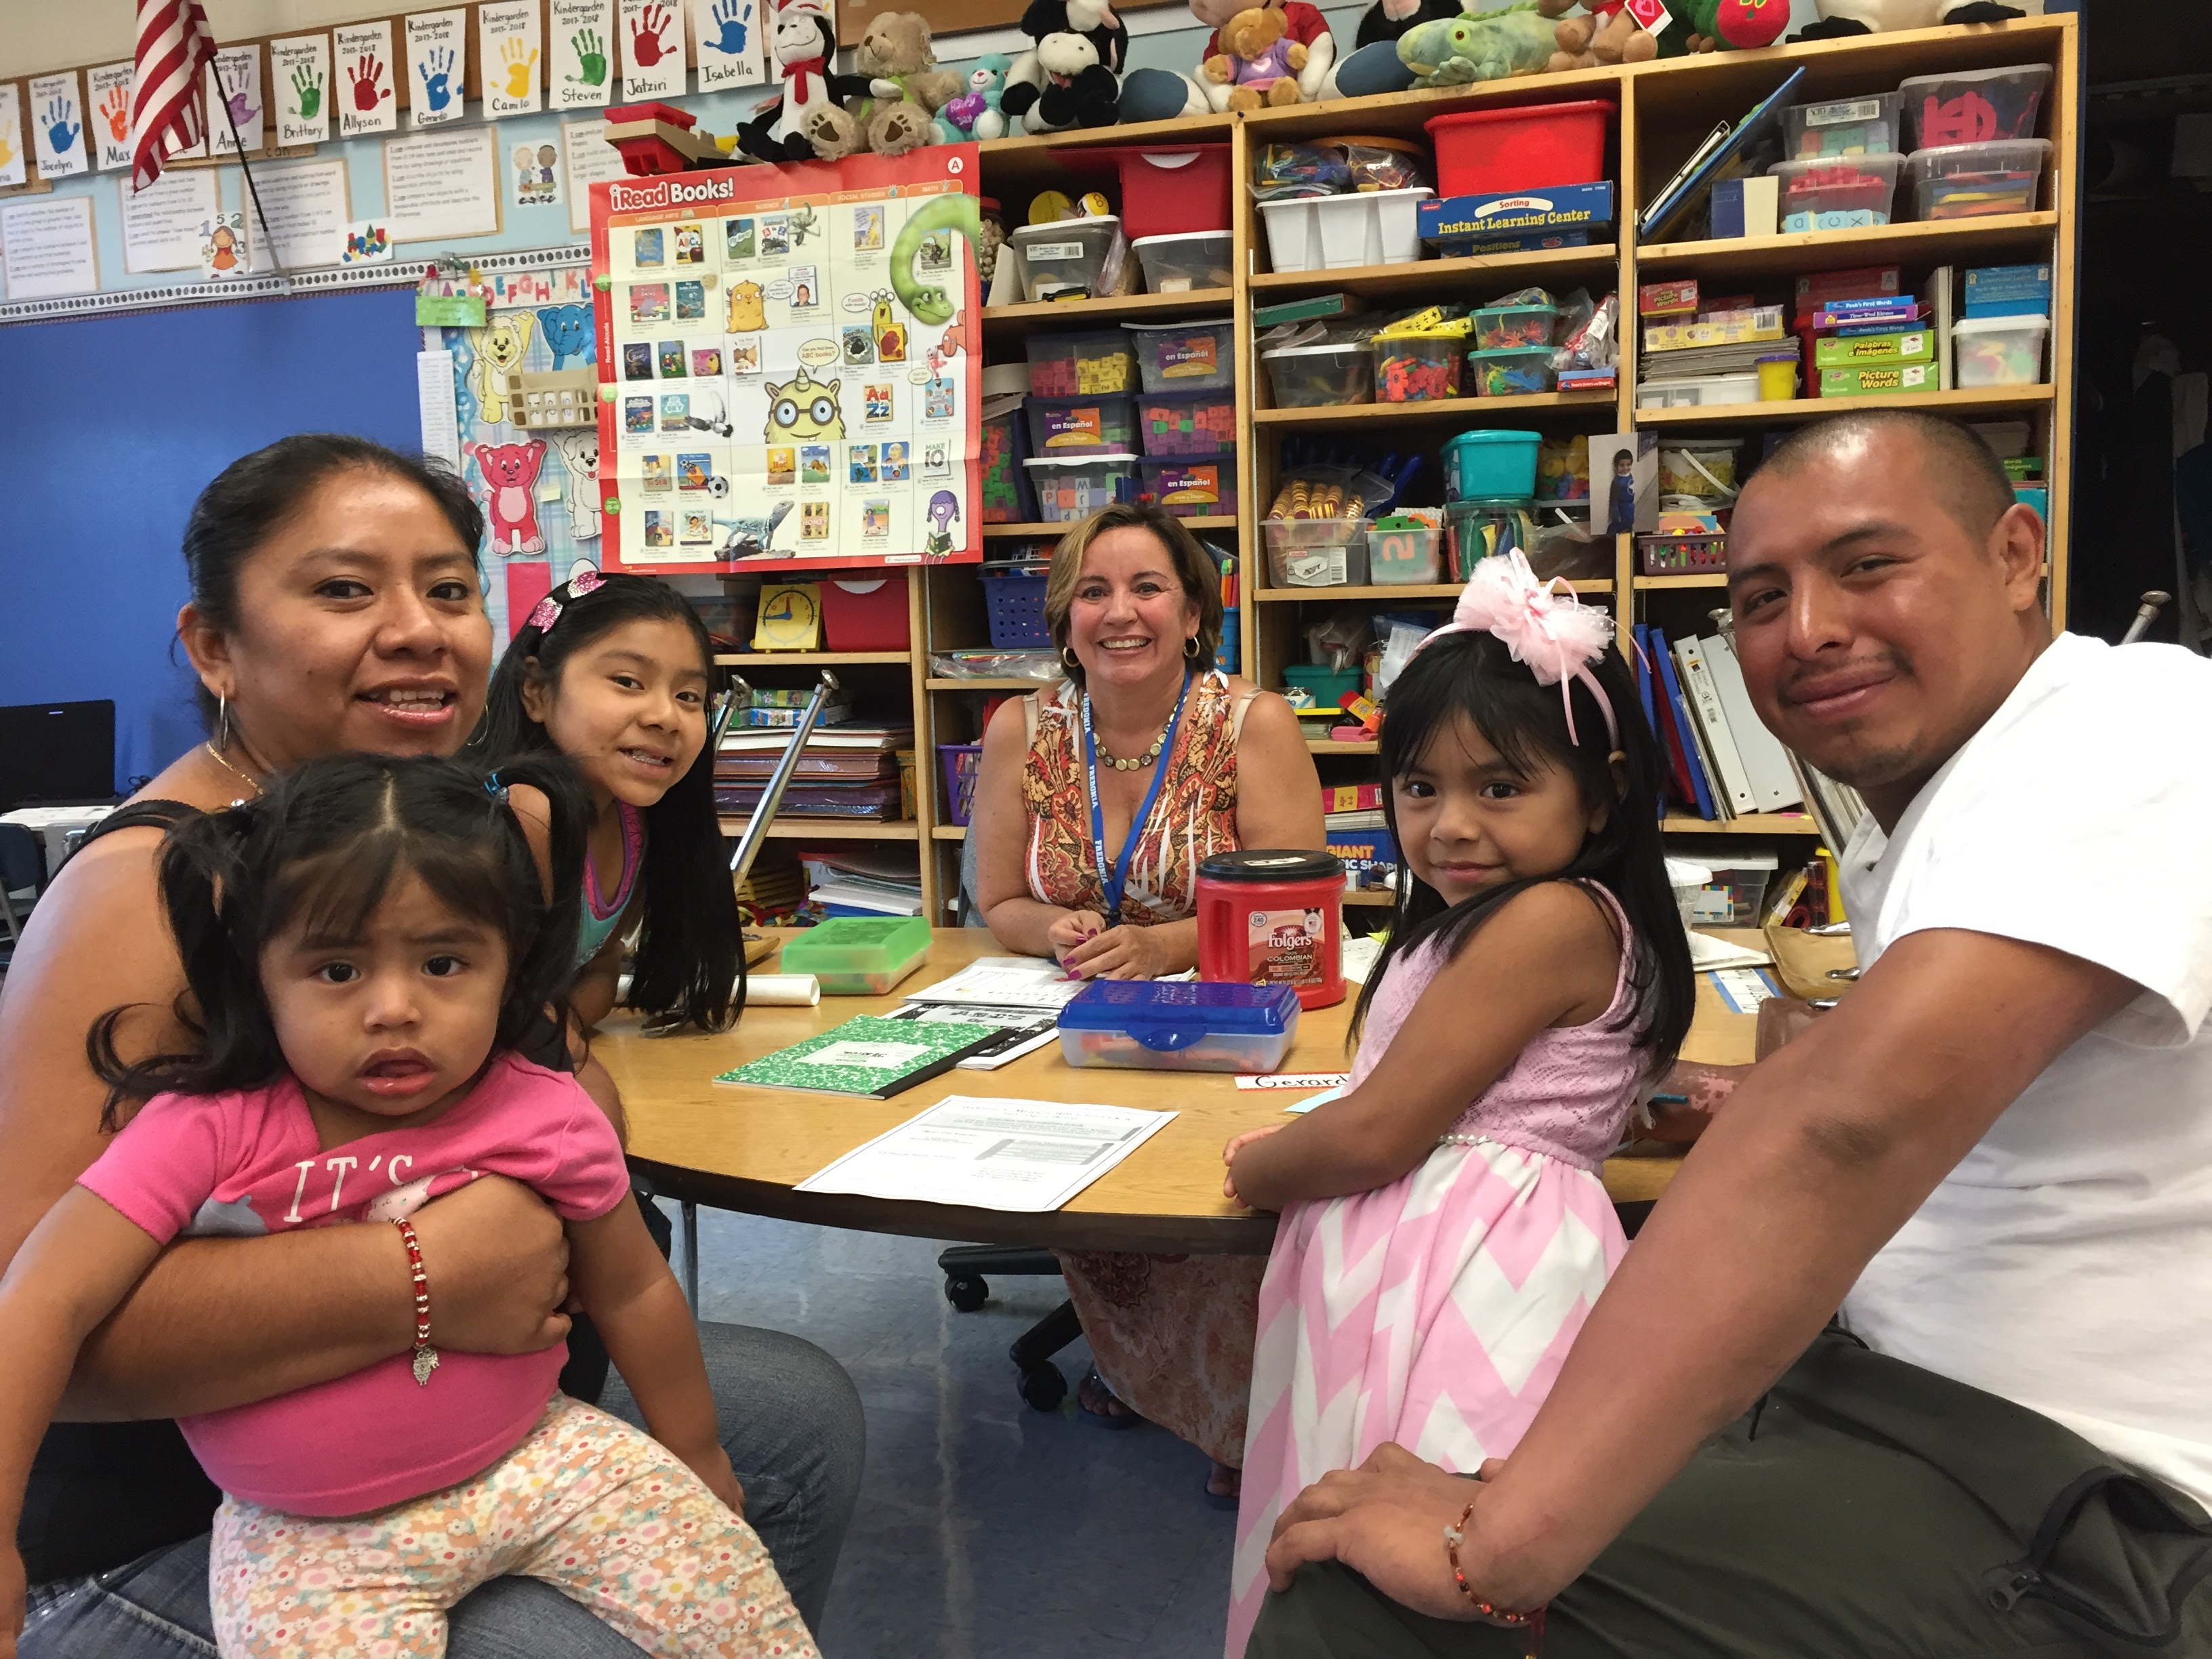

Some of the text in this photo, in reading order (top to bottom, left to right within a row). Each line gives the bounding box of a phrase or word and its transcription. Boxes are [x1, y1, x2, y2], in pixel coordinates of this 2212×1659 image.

[701, 60, 753, 83] Isabella
[626, 78, 667, 96] Jatziri
[562, 87, 602, 102] Steven
[492, 98, 529, 110] Camilo
[343, 112, 382, 132] Allyson
[106, 146, 131, 165] Max
[41, 159, 73, 173] Jocelyn
[951, 161, 960, 170] A
[610, 178, 734, 211] iRead Books!
[1500, 200, 1530, 209] Sorting
[1438, 209, 1591, 234] Instant Learning Center
[1472, 240, 1521, 253] Positions
[1854, 340, 1891, 350] Palabras
[1856, 346, 1898, 356] imágenes
[1858, 370, 1900, 380] Picture
[1862, 380, 1899, 389] Words
[1063, 421, 1093, 430] Español
[925, 450, 945, 467] 10
[1179, 478, 1210, 487] Español
[1083, 693, 1091, 736] FREDONIA
[1089, 765, 1099, 810] FREDONIA
[1326, 845, 1374, 858] GIANT
[1095, 840, 1108, 886] FREDONIA
[1269, 933, 1312, 950] Folgers
